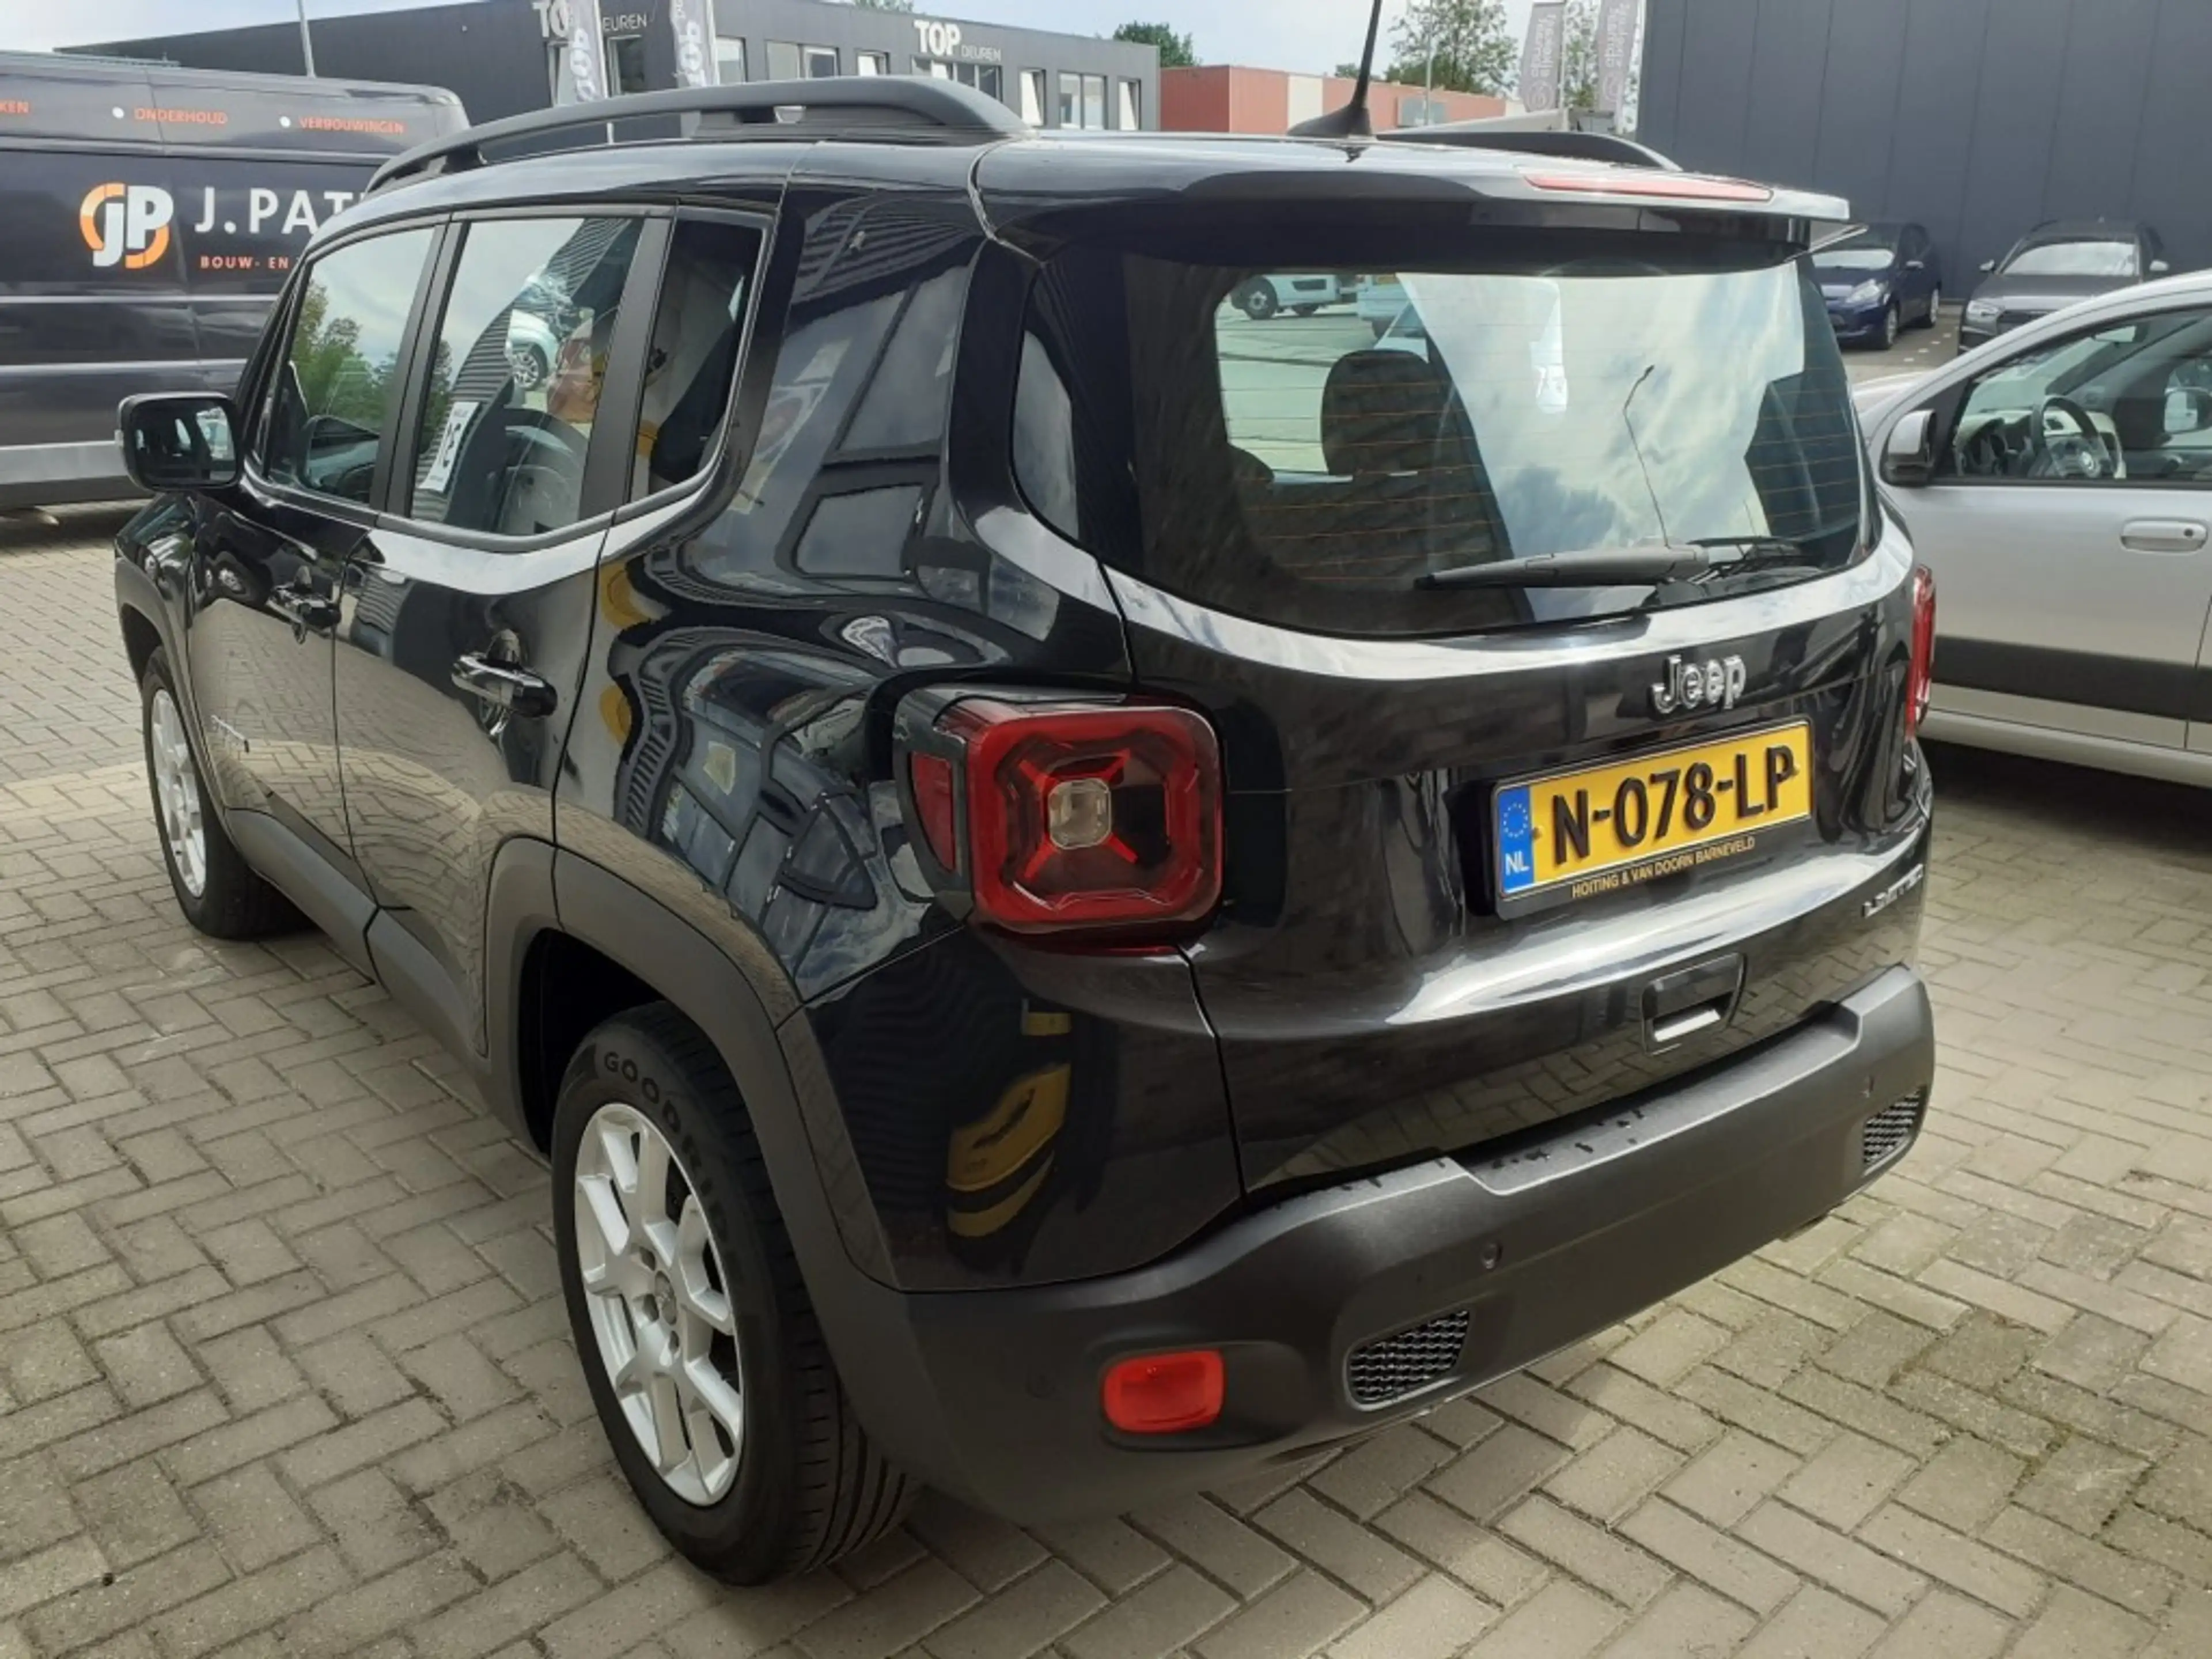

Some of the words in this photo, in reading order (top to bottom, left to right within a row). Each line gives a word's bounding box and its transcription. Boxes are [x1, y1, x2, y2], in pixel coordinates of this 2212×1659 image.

[532, 2, 569, 38] TO
[603, 14, 647, 32] EUREN
[914, 19, 961, 56] TOP
[134, 108, 228, 125] ONDERHOUD
[300, 116, 404, 134] VERBOUWINGEN
[194, 186, 366, 235] J.PAT
[200, 256, 260, 270] BOUW-
[268, 256, 288, 269] EN
[1652, 654, 1746, 714] Jeep
[1552, 745, 1795, 866] N-078-LP
[1505, 851, 1529, 876] NL
[1572, 875, 1619, 899] HOITING
[1622, 871, 1631, 885] &
[1631, 863, 1654, 882] VAN
[1654, 854, 1694, 876] DOORN
[1695, 837, 1755, 863] BARNEVELD
